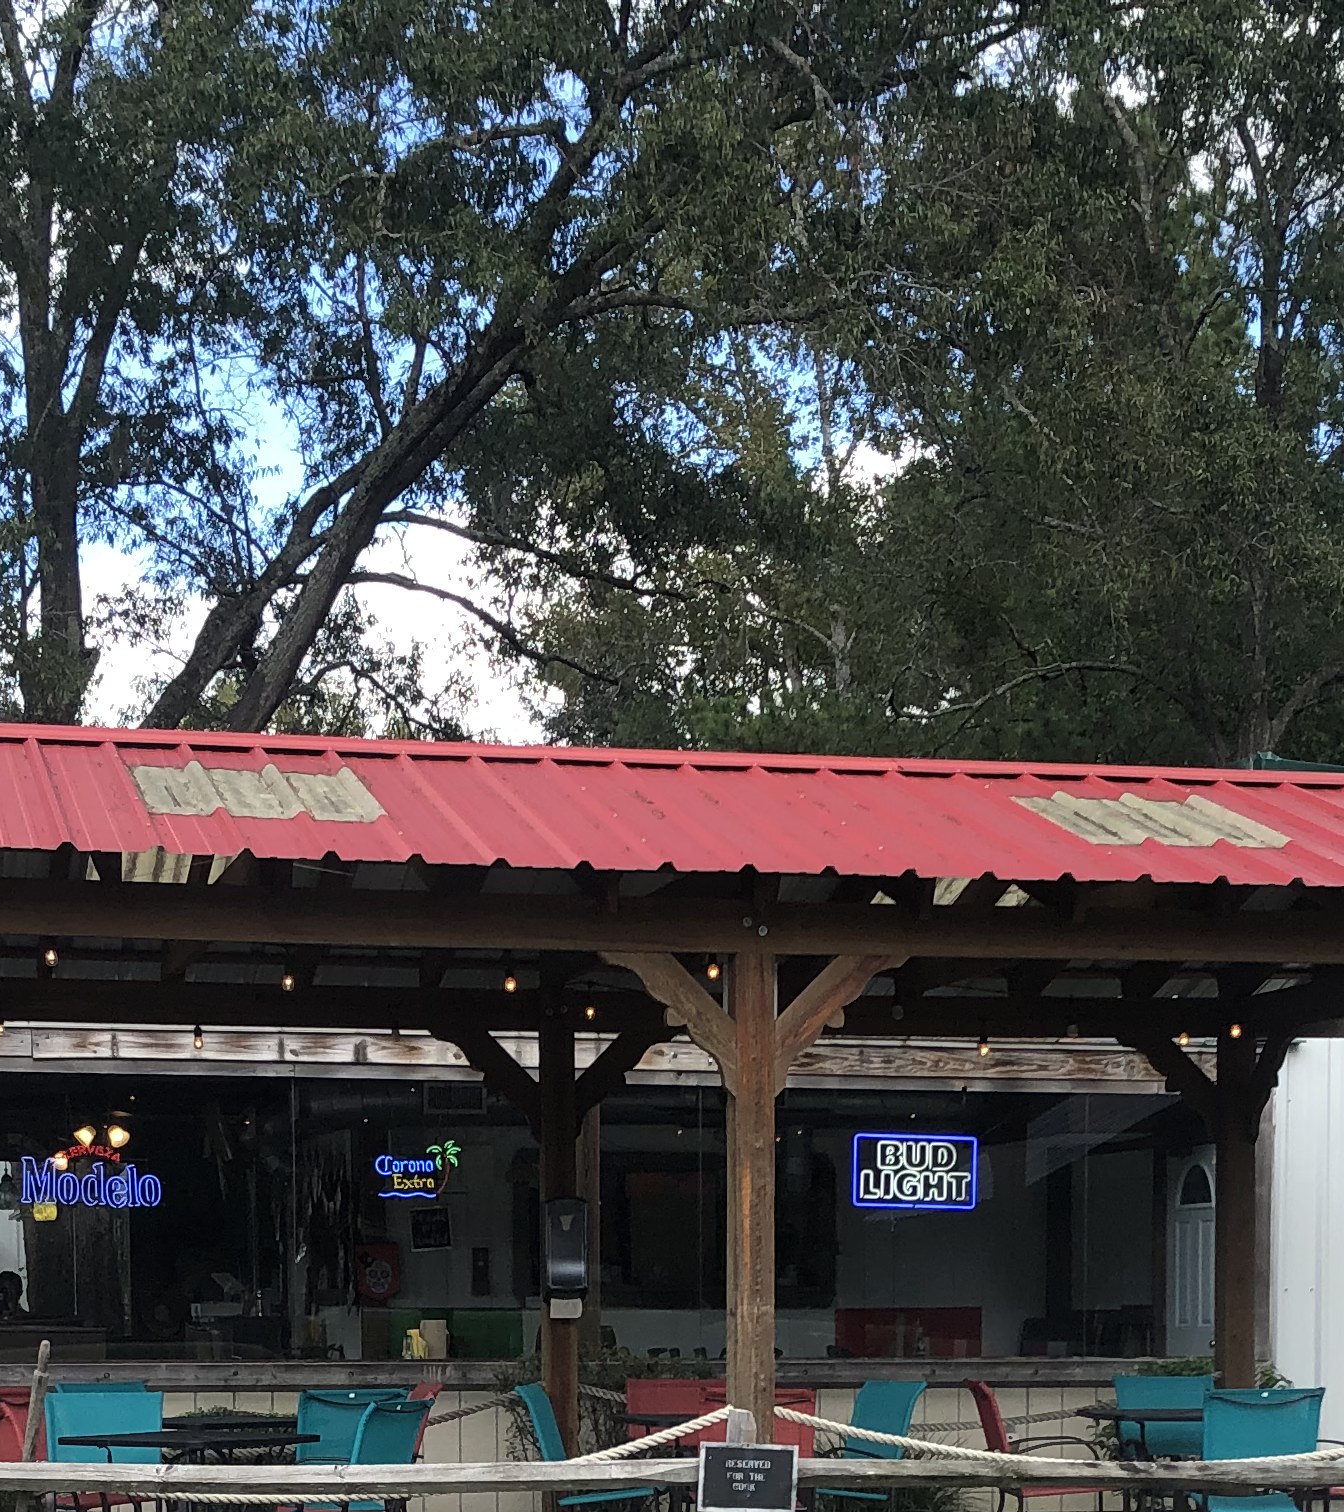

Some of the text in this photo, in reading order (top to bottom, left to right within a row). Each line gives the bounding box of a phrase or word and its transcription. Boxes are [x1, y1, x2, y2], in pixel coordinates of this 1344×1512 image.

[374, 1155, 434, 1175] Corona
[877, 1140, 957, 1171] BUD
[20, 1156, 162, 1208] Modelo
[392, 1173, 435, 1190] Extra
[859, 1169, 971, 1201] LIGHT
[725, 1459, 771, 1469] RESERVED
[726, 1471, 744, 1481] FOR
